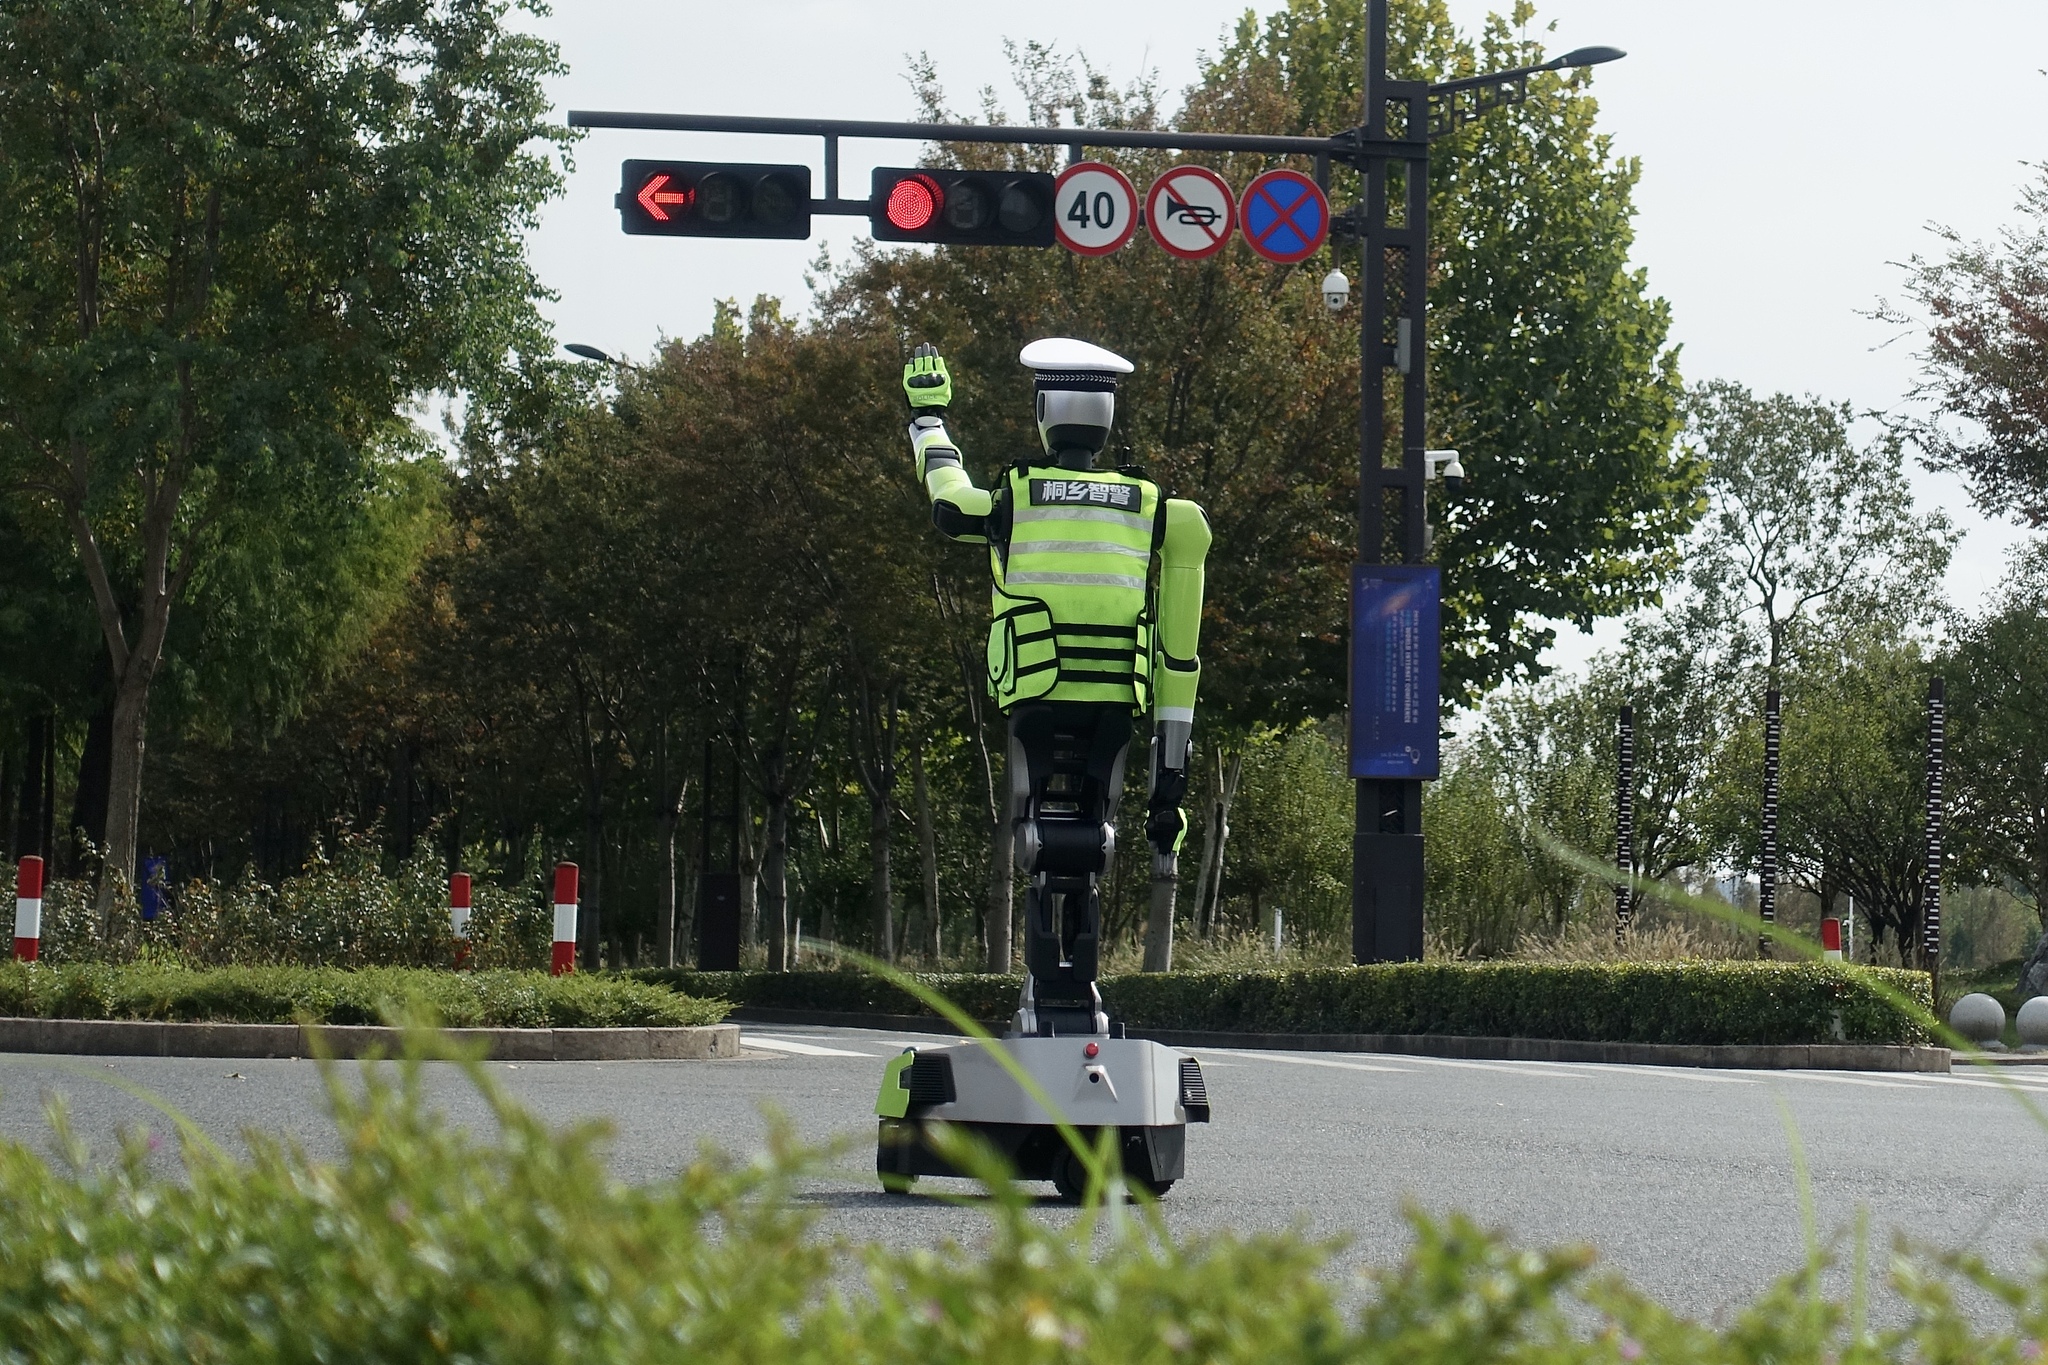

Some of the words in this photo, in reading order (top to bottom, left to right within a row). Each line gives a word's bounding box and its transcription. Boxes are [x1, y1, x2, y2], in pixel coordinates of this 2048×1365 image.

[1067, 190, 1115, 229] 40
[1042, 480, 1131, 506] 桐乡智警
